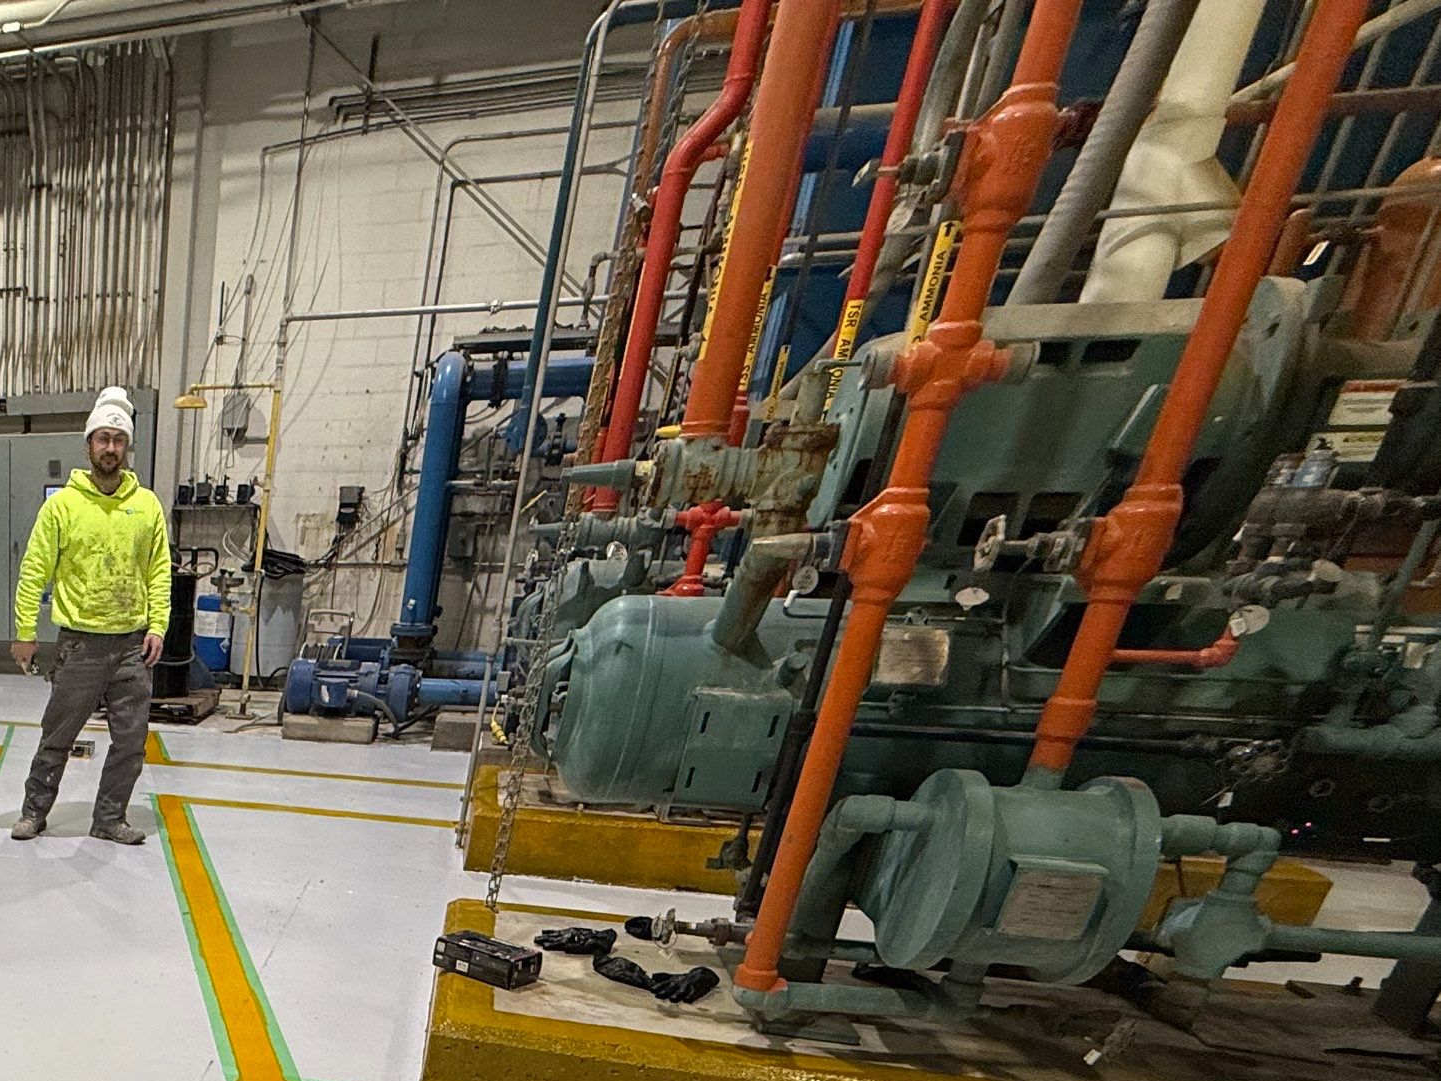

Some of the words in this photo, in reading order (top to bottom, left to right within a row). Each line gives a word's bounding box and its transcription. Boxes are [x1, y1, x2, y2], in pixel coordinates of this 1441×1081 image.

[845, 303, 863, 329] TSR
[920, 250, 947, 321] AMMONIA
[825, 339, 851, 400] AMONIA
